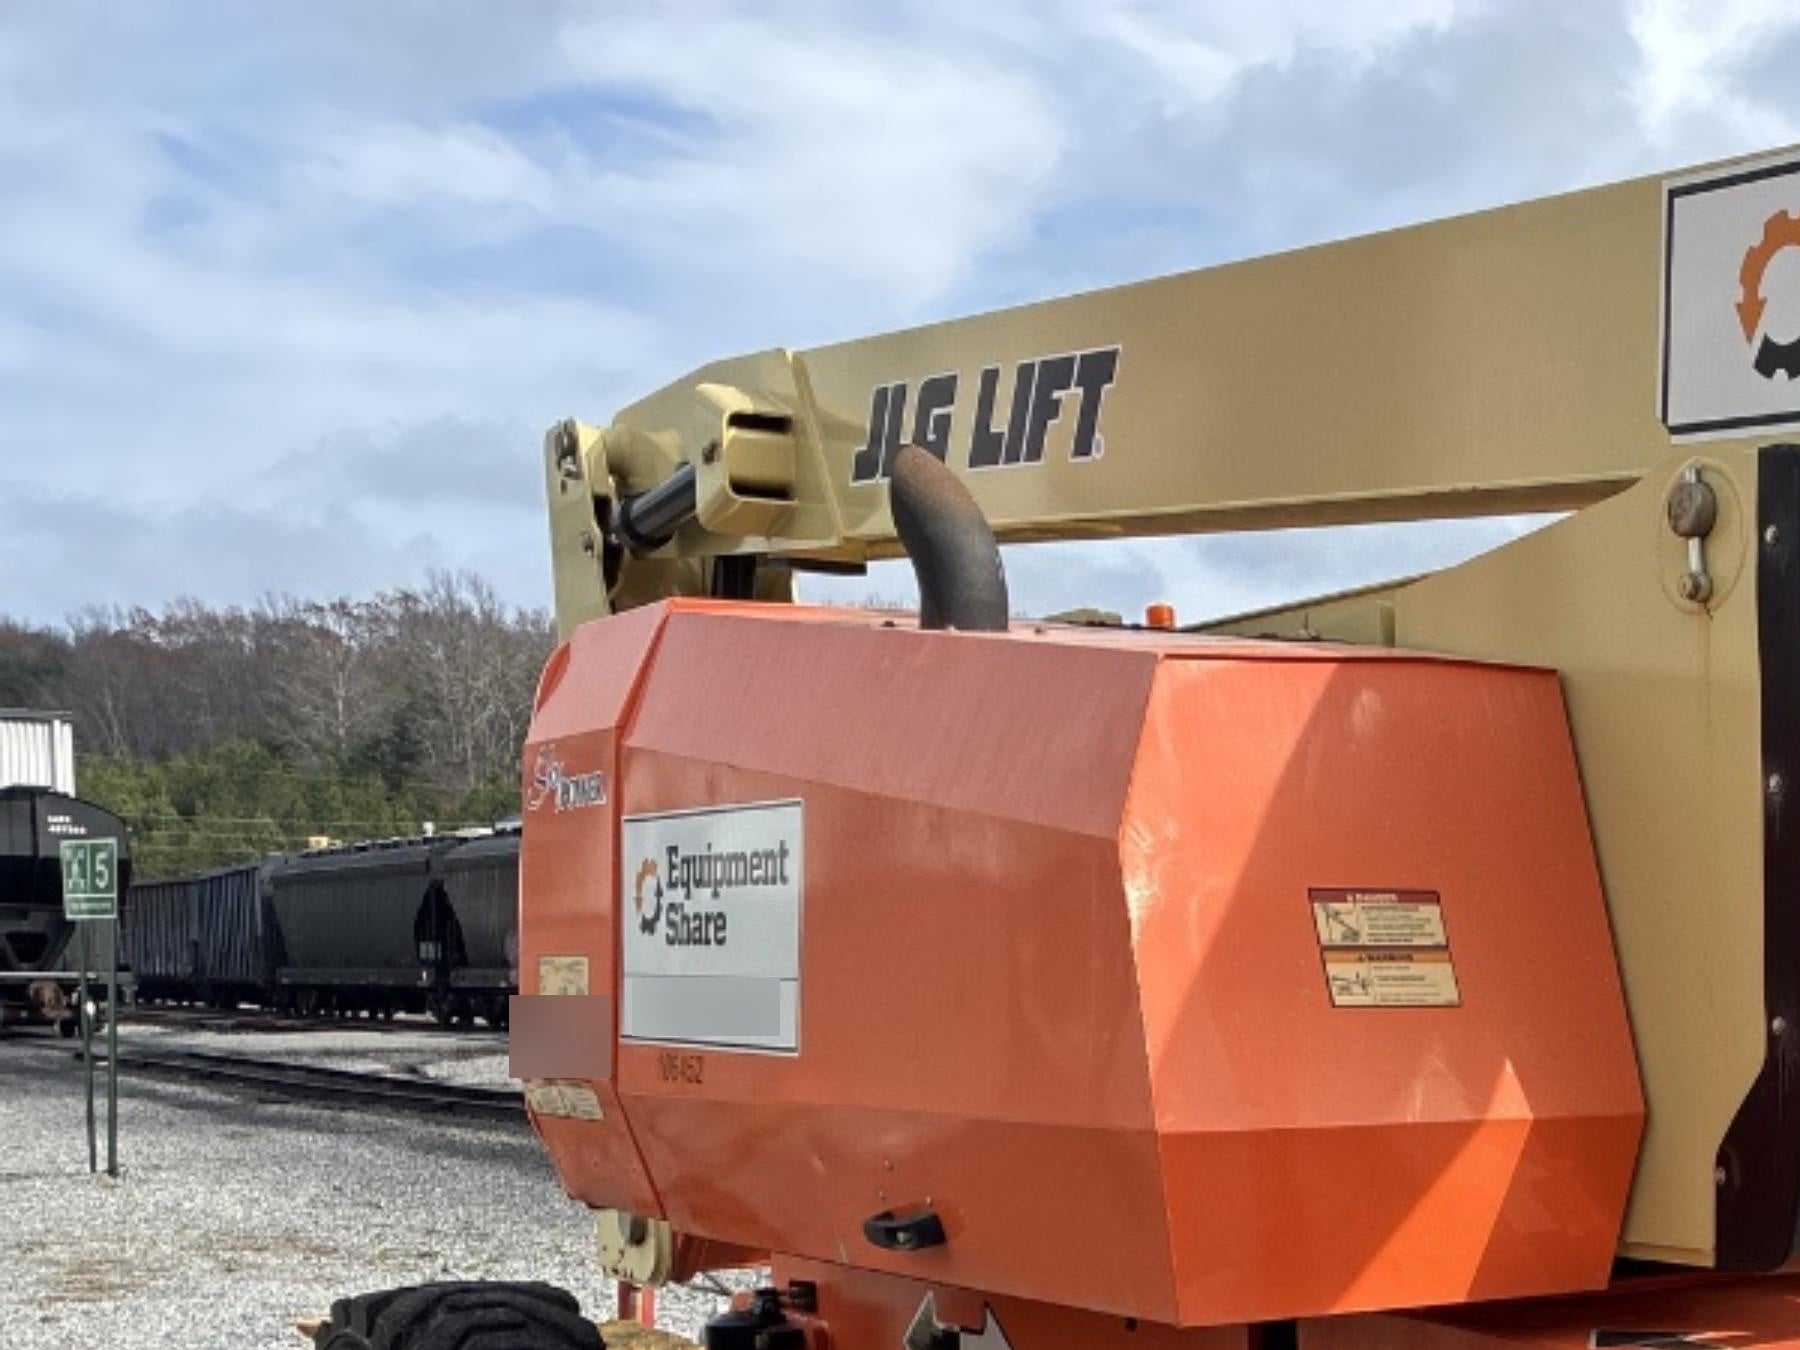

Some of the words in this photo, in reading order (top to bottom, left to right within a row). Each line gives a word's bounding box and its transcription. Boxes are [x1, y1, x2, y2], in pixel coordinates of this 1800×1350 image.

[849, 372, 959, 486] JLG
[967, 345, 1121, 469] LIFT
[665, 839, 790, 900] Equipment
[665, 902, 728, 946] Share
